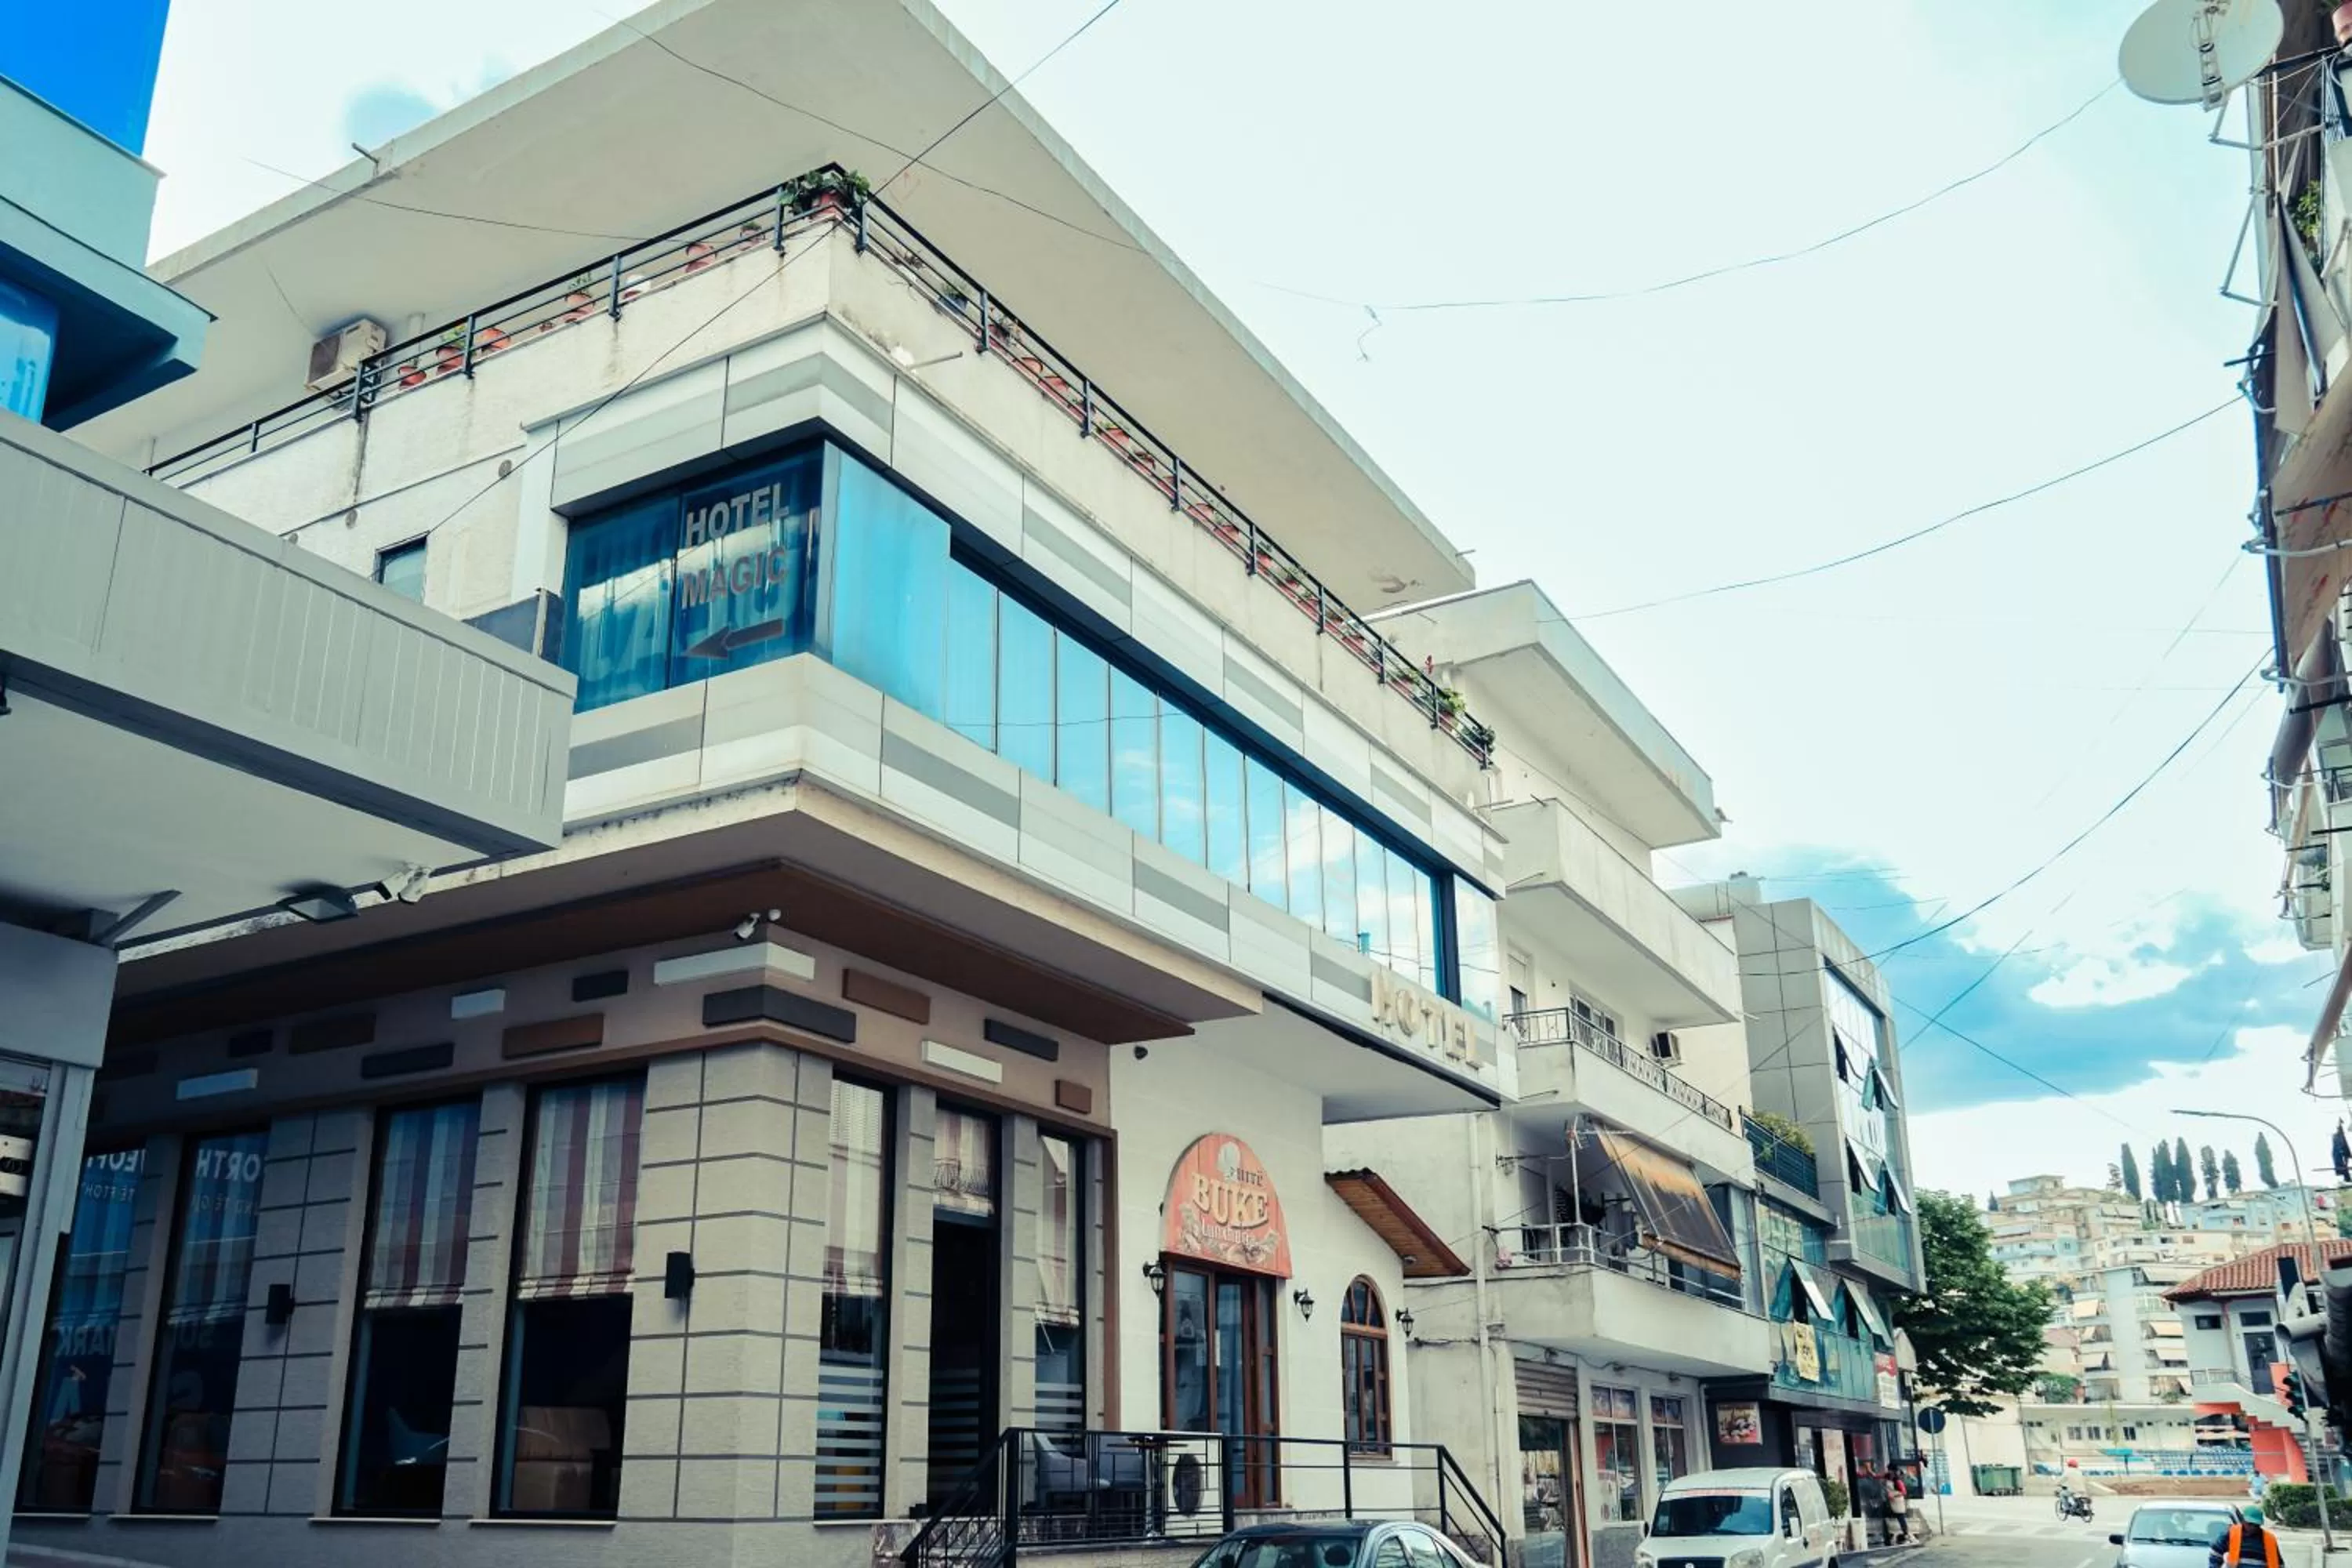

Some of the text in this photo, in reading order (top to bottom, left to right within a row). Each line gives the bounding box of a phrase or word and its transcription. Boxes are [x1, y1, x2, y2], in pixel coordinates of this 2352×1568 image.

[685, 482, 789, 549] HOTEL
[681, 546, 789, 610] MAGIC
[1370, 967, 1483, 1070] HOTEL
[1192, 1173, 1269, 1229] BUKE
